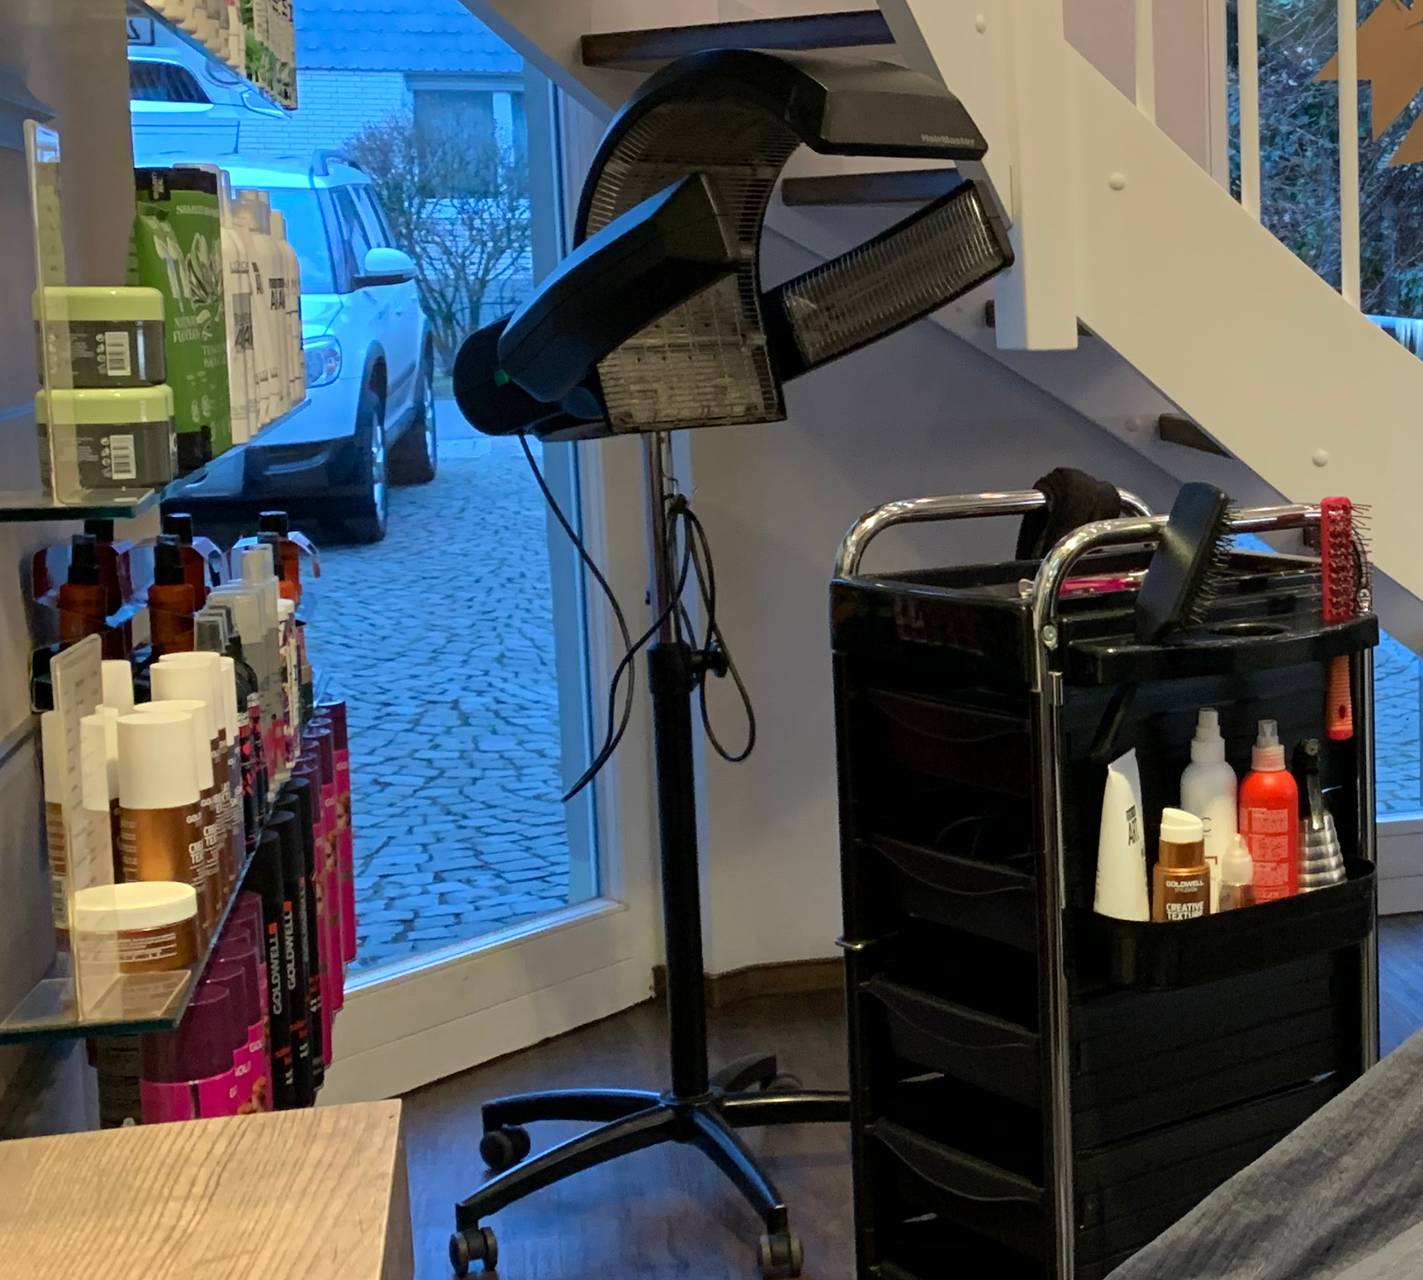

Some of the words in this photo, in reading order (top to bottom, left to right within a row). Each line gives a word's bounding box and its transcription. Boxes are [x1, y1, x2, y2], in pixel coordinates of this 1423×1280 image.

[1166, 880, 1204, 888] GOLDWELL
[1166, 901, 1204, 912] CREATIVE
[285, 911, 297, 990] GOLDWELL
[268, 933, 283, 1015] GOLDWELL
